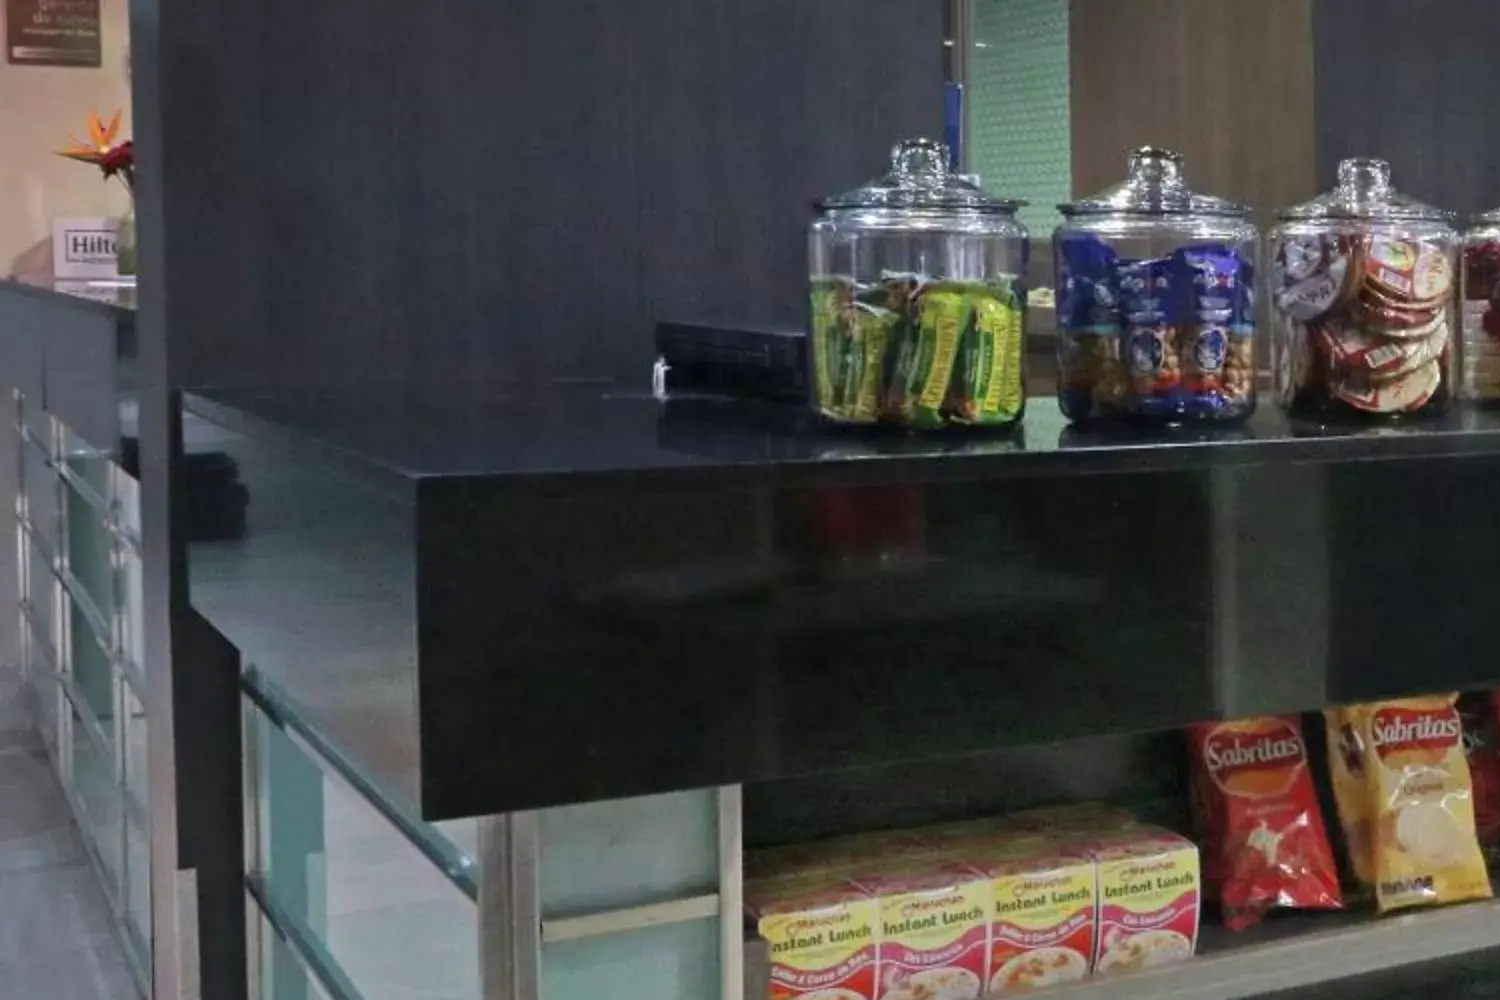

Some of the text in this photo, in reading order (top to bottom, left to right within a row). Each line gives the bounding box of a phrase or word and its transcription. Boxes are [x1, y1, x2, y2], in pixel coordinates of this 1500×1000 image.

[1373, 716, 1460, 747] Sabritas
[1206, 736, 1300, 770] Sabritas
[995, 885, 1091, 913] Instant Lunch
[1104, 871, 1194, 898] Instant Lunch
[883, 905, 984, 937] Instant Lunch
[772, 924, 872, 954] nstant Lunch
